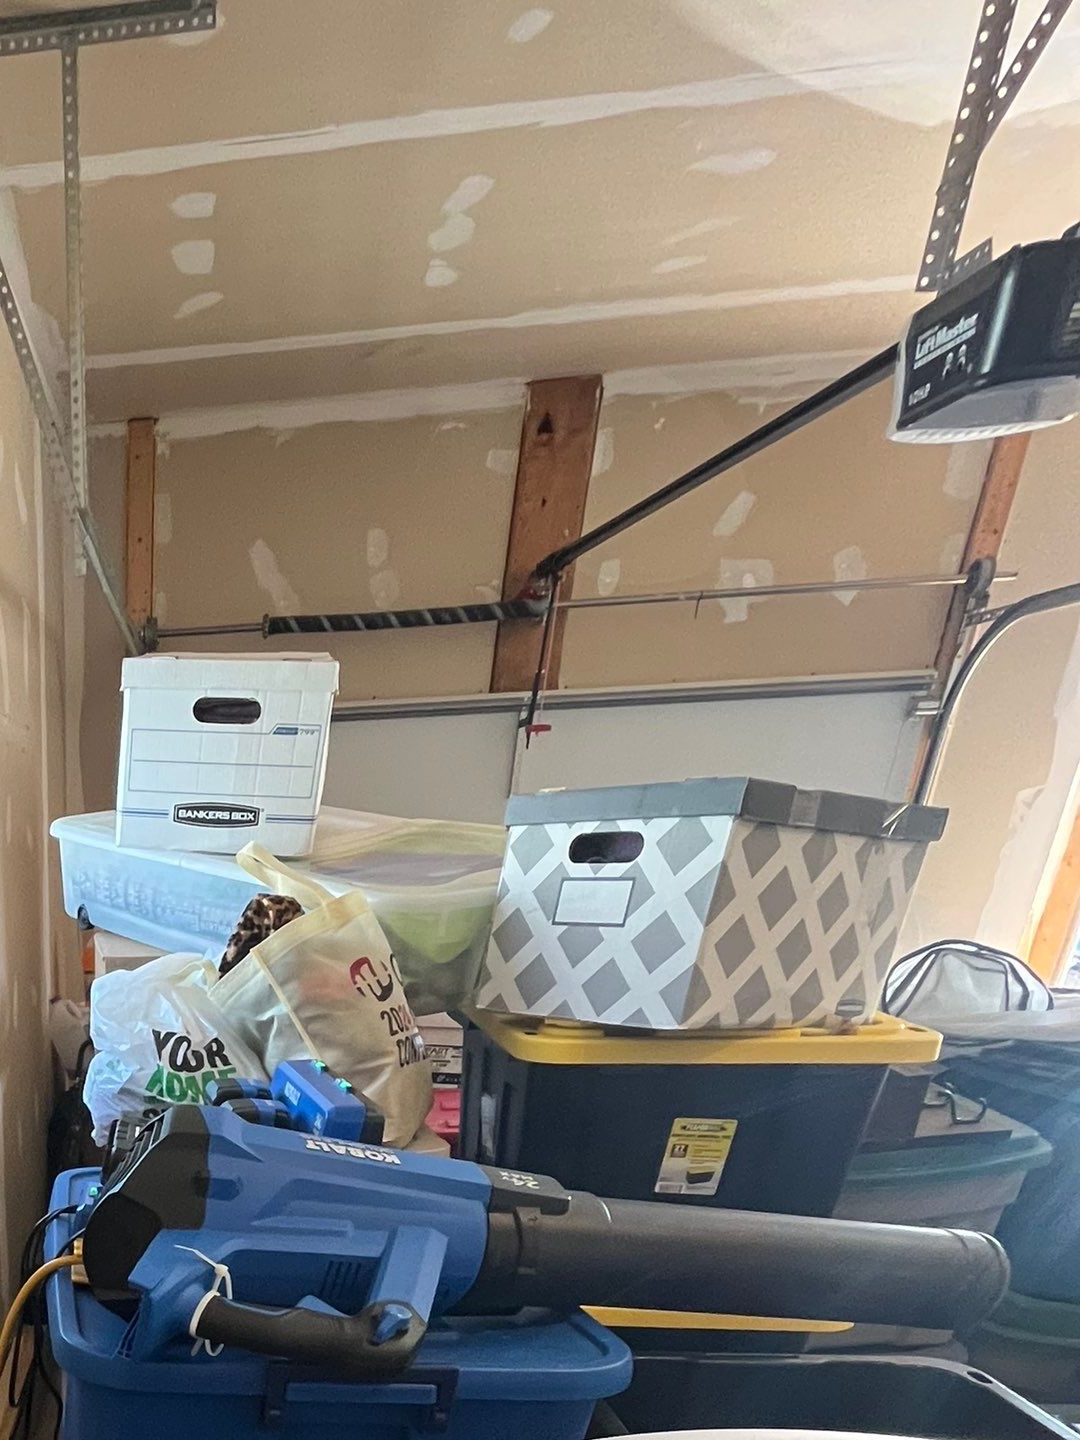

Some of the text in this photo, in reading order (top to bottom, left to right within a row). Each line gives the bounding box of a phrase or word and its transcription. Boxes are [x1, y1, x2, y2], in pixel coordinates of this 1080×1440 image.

[178, 808, 255, 821] BANKERS BOX
[305, 1139, 402, 1165] KOBALT
